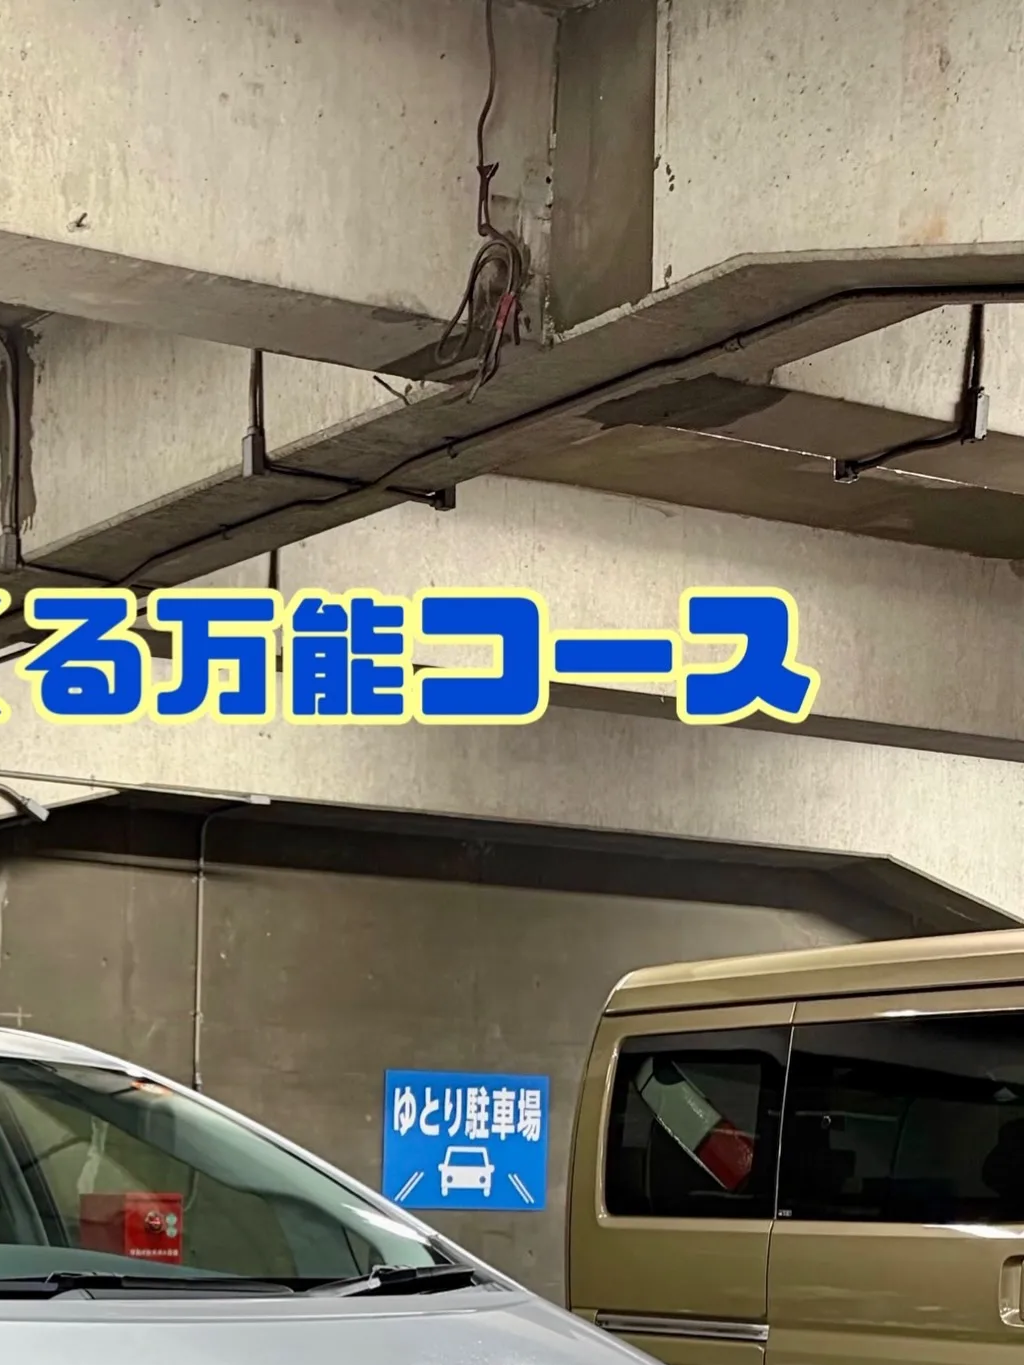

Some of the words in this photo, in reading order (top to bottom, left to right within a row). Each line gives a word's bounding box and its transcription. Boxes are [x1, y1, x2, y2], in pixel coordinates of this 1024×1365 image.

[392, 1086, 541, 1141] ゆとり駐車場
